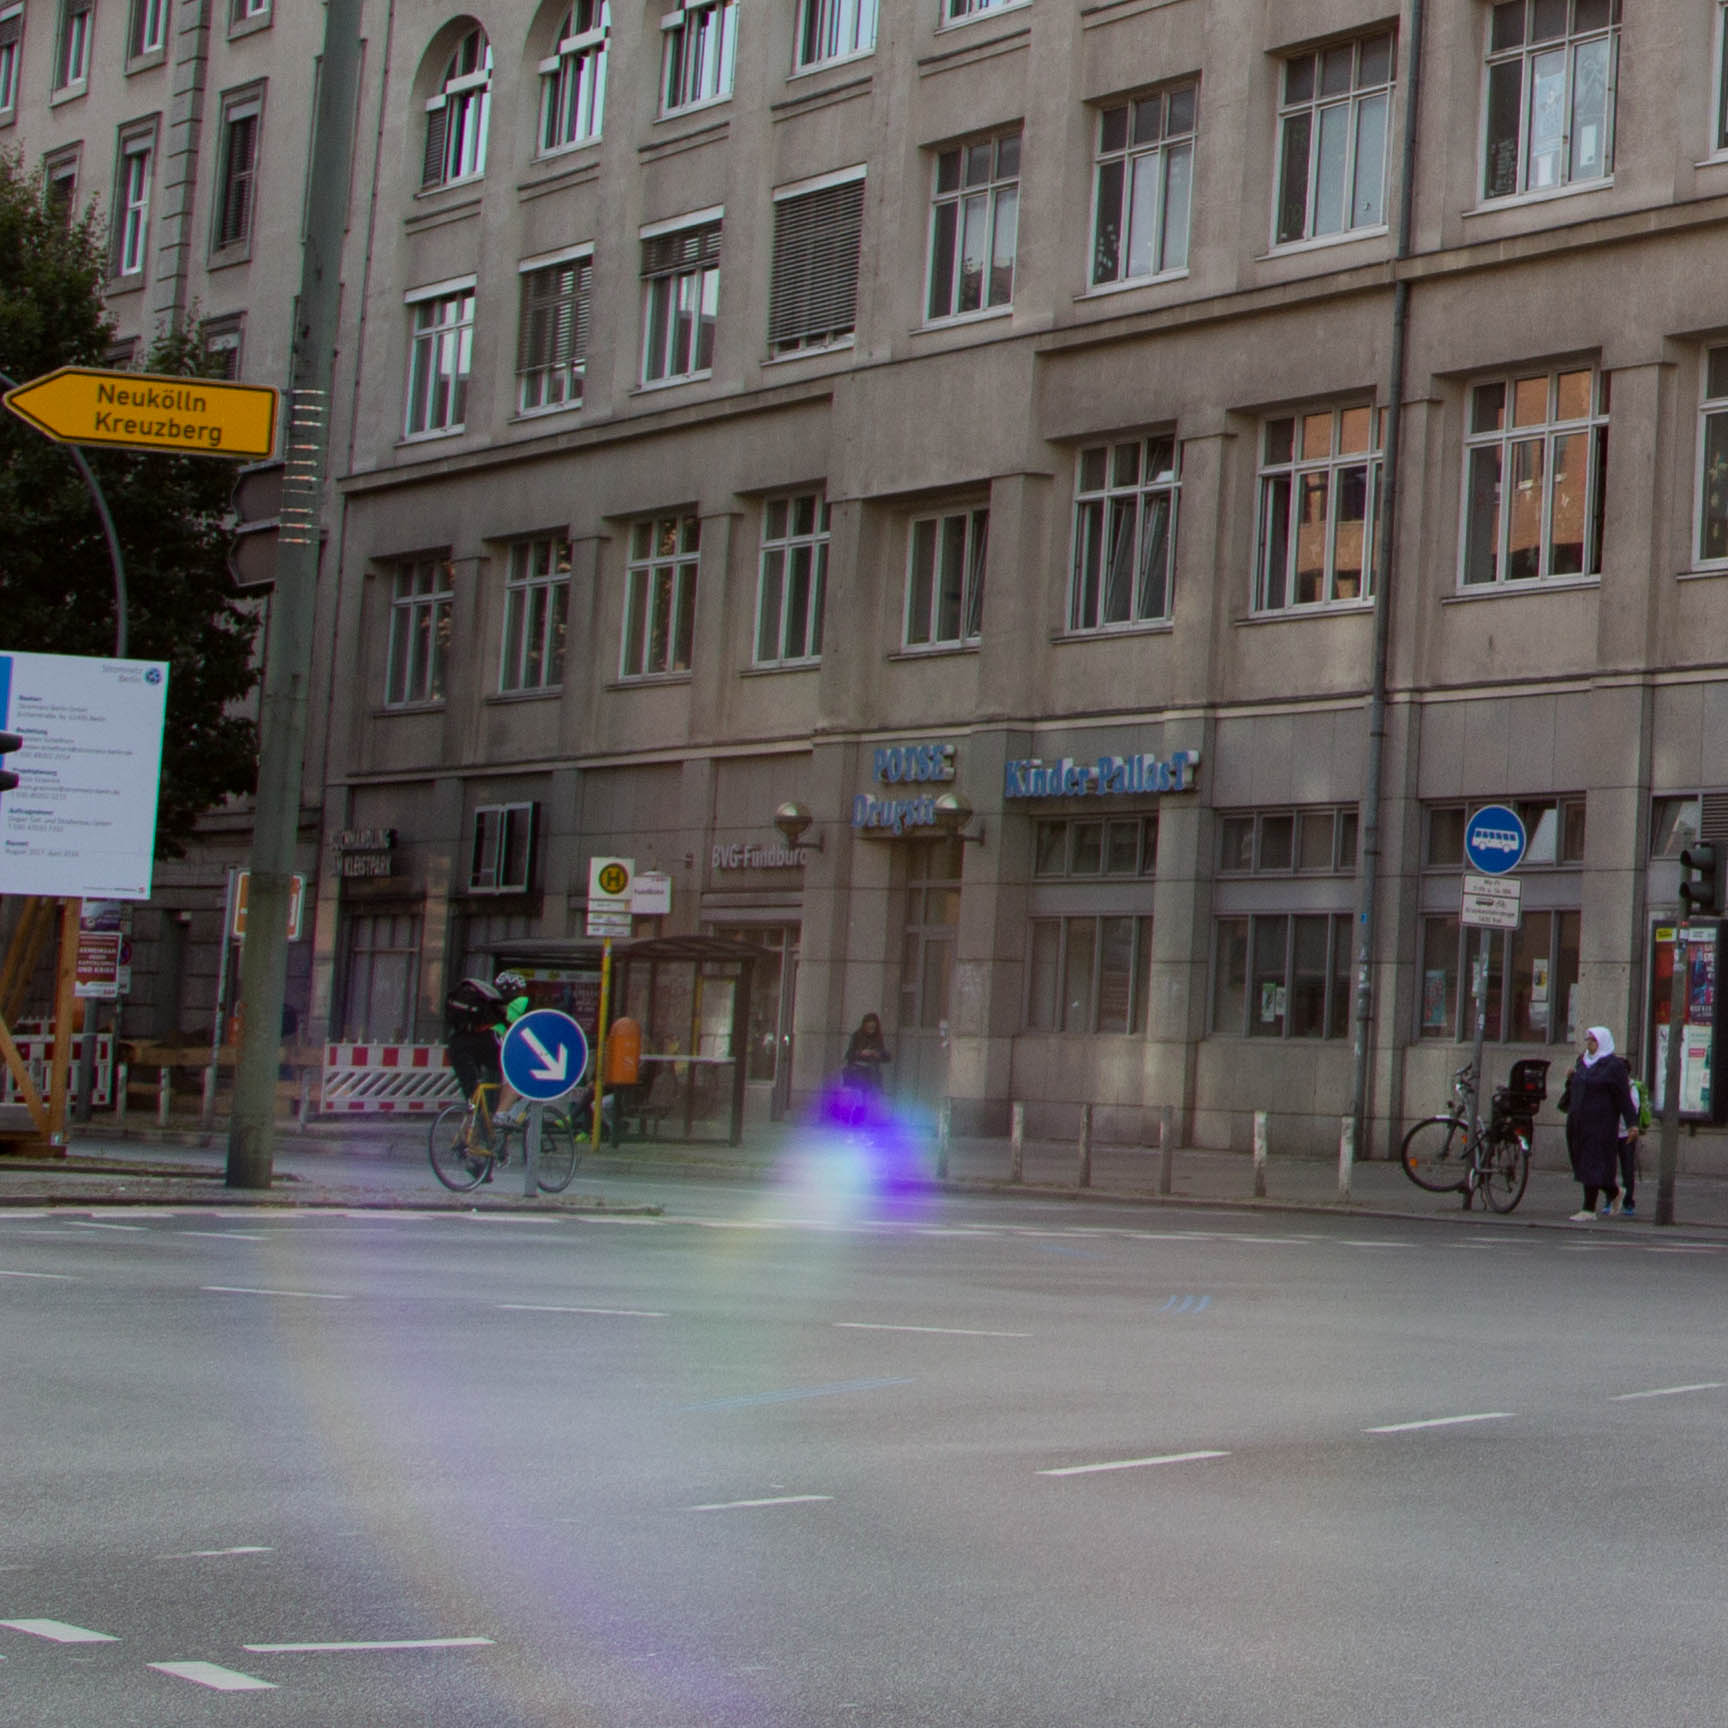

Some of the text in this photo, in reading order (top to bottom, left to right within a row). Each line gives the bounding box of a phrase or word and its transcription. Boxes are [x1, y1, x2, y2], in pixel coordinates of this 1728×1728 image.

[97, 384, 206, 413] Neukölln
[94, 412, 222, 446] Kreuzberg
[1005, 751, 1194, 798] Kinder PallasT
